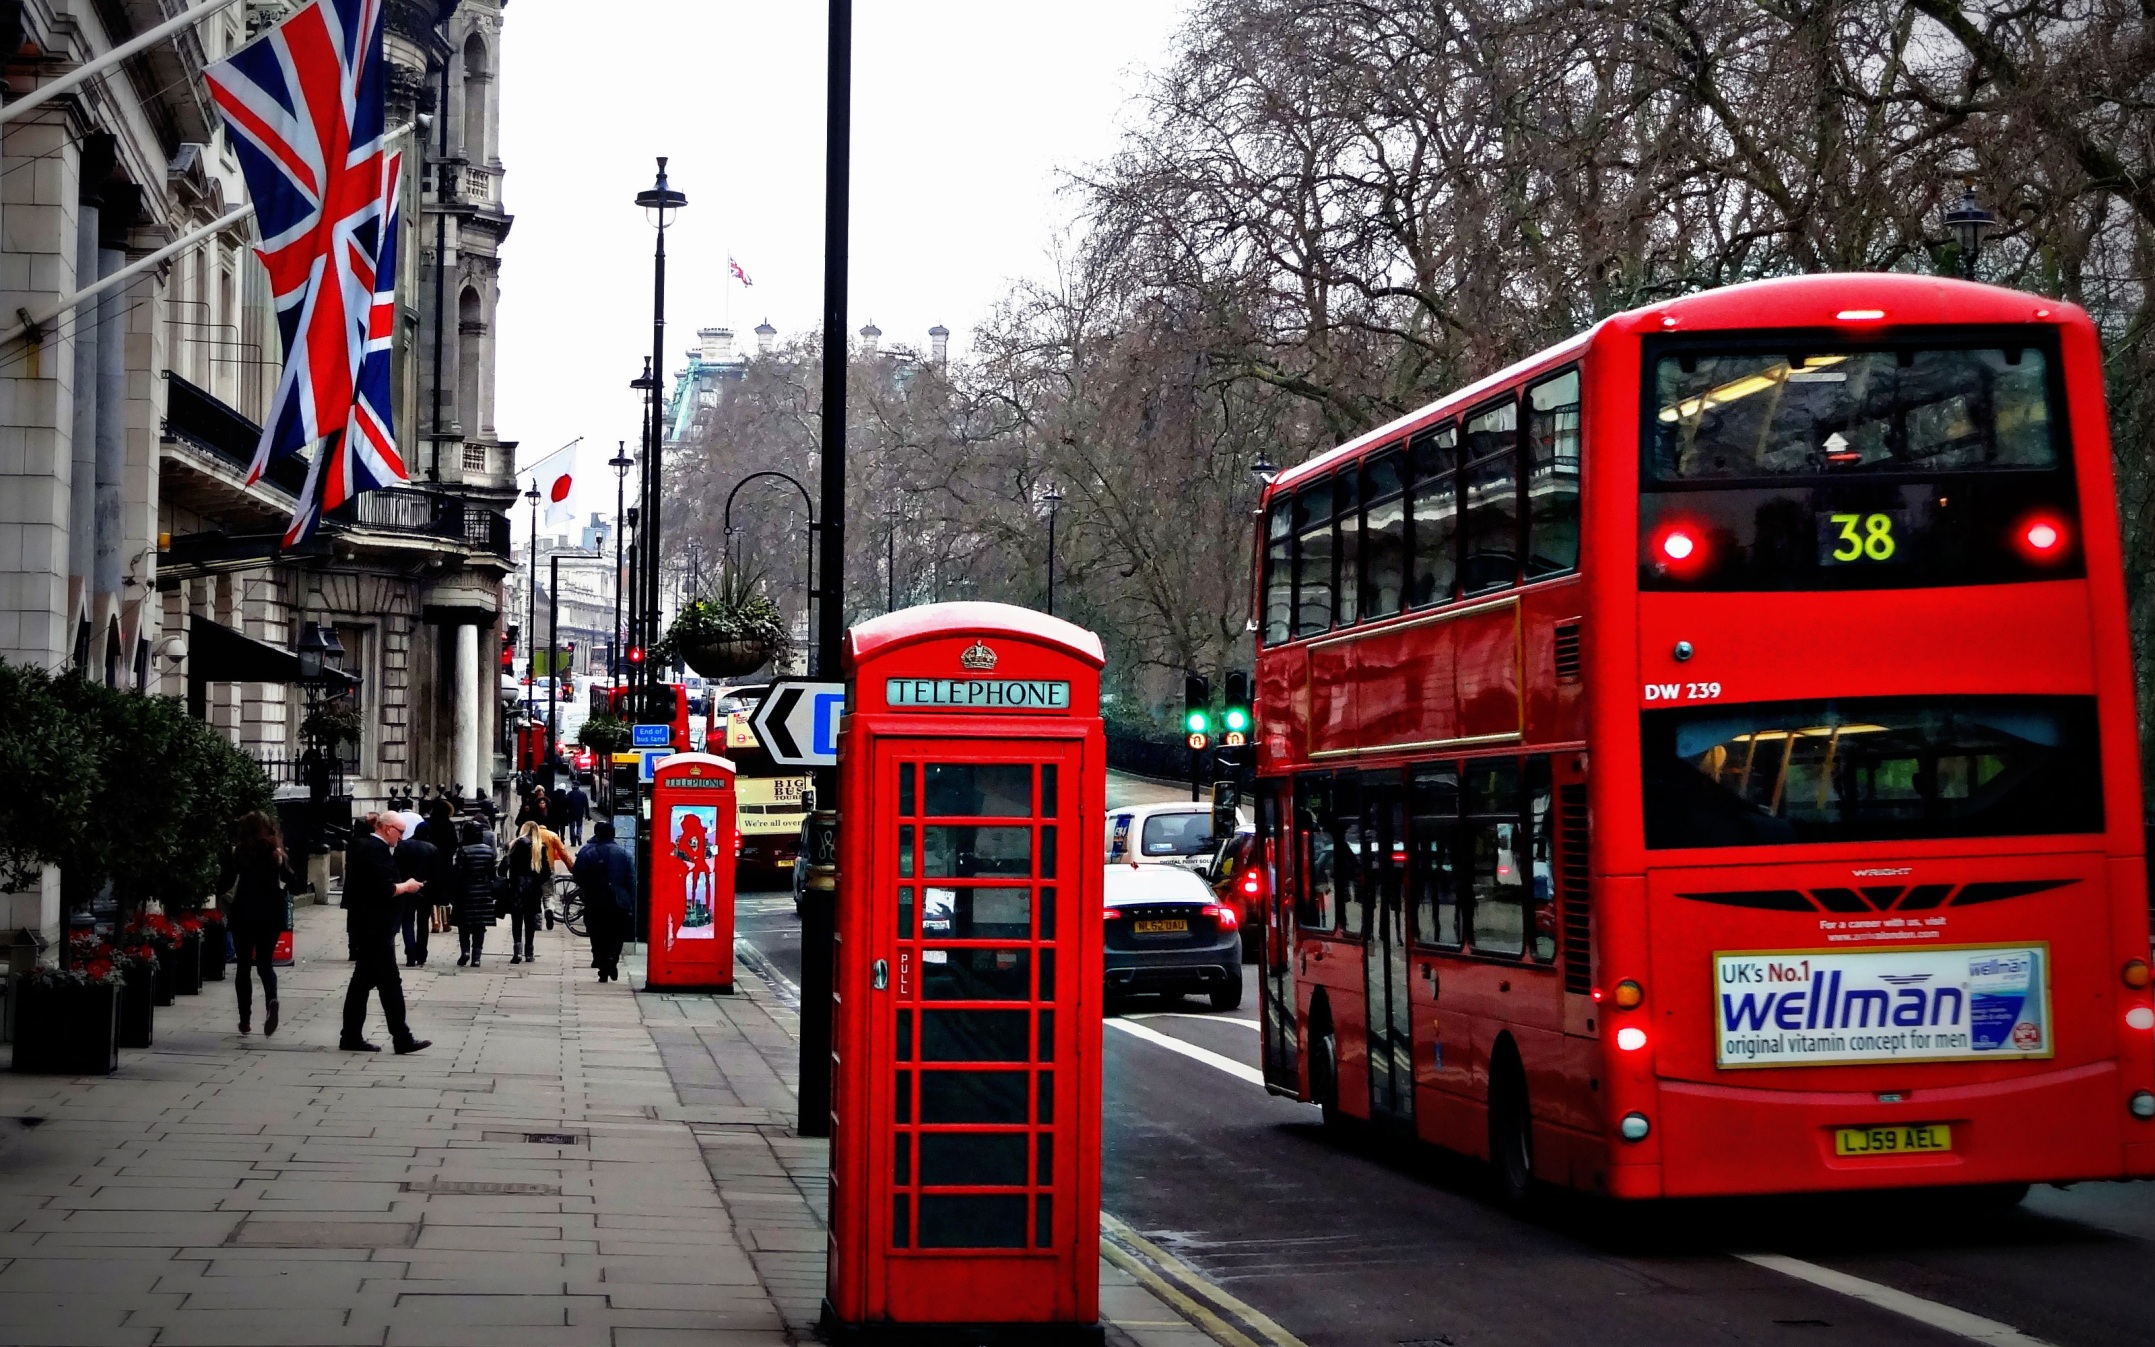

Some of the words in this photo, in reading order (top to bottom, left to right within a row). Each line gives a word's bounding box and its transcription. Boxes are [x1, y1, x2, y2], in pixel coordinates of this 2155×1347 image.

[1830, 513, 1895, 561] 38
[893, 680, 1062, 705] TELEPHONE
[1645, 684, 1680, 700] DW
[1686, 682, 1721, 698] 239
[655, 727, 663, 735] of
[668, 778, 724, 788] TELEPHONE
[774, 779, 804, 788] BIG
[774, 787, 803, 796] BUS
[745, 819, 768, 827] We're
[770, 819, 780, 827] all
[1819, 920, 1837, 930] For
[1838, 921, 1847, 929] a
[1722, 963, 1763, 984] UK's
[1768, 960, 1810, 983] No.1
[1722, 970, 1962, 1032] wellman
[1726, 1034, 1785, 1059] original
[1788, 1033, 1846, 1053] vitamin
[1849, 1030, 1907, 1055] concept
[1910, 1029, 1931, 1050] for
[1935, 1032, 1968, 1049] men
[1843, 1130, 1898, 1152] LJ59
[1904, 1128, 1943, 1149] AEL
